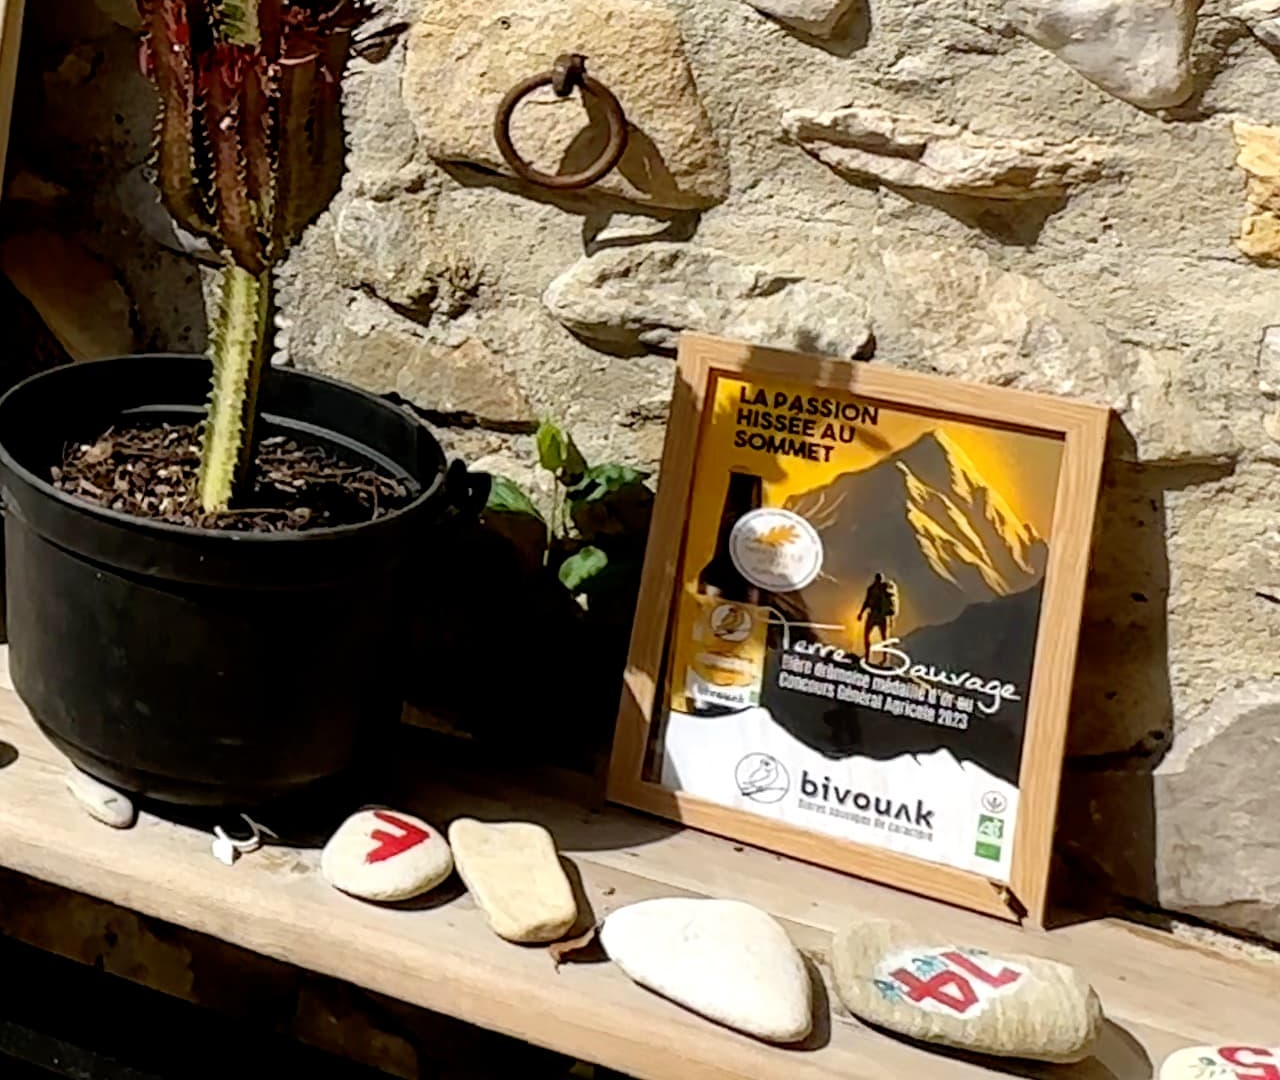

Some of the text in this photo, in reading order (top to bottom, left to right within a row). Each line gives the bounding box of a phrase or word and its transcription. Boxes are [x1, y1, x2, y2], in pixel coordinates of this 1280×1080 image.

[739, 386, 879, 425] LA PASSION
[736, 408, 856, 443] HISSÉE AU
[734, 429, 835, 462] SOMMET
[758, 604, 1022, 716] Terre Sauvage
[778, 670, 970, 730] Concours Général Agricole 2023
